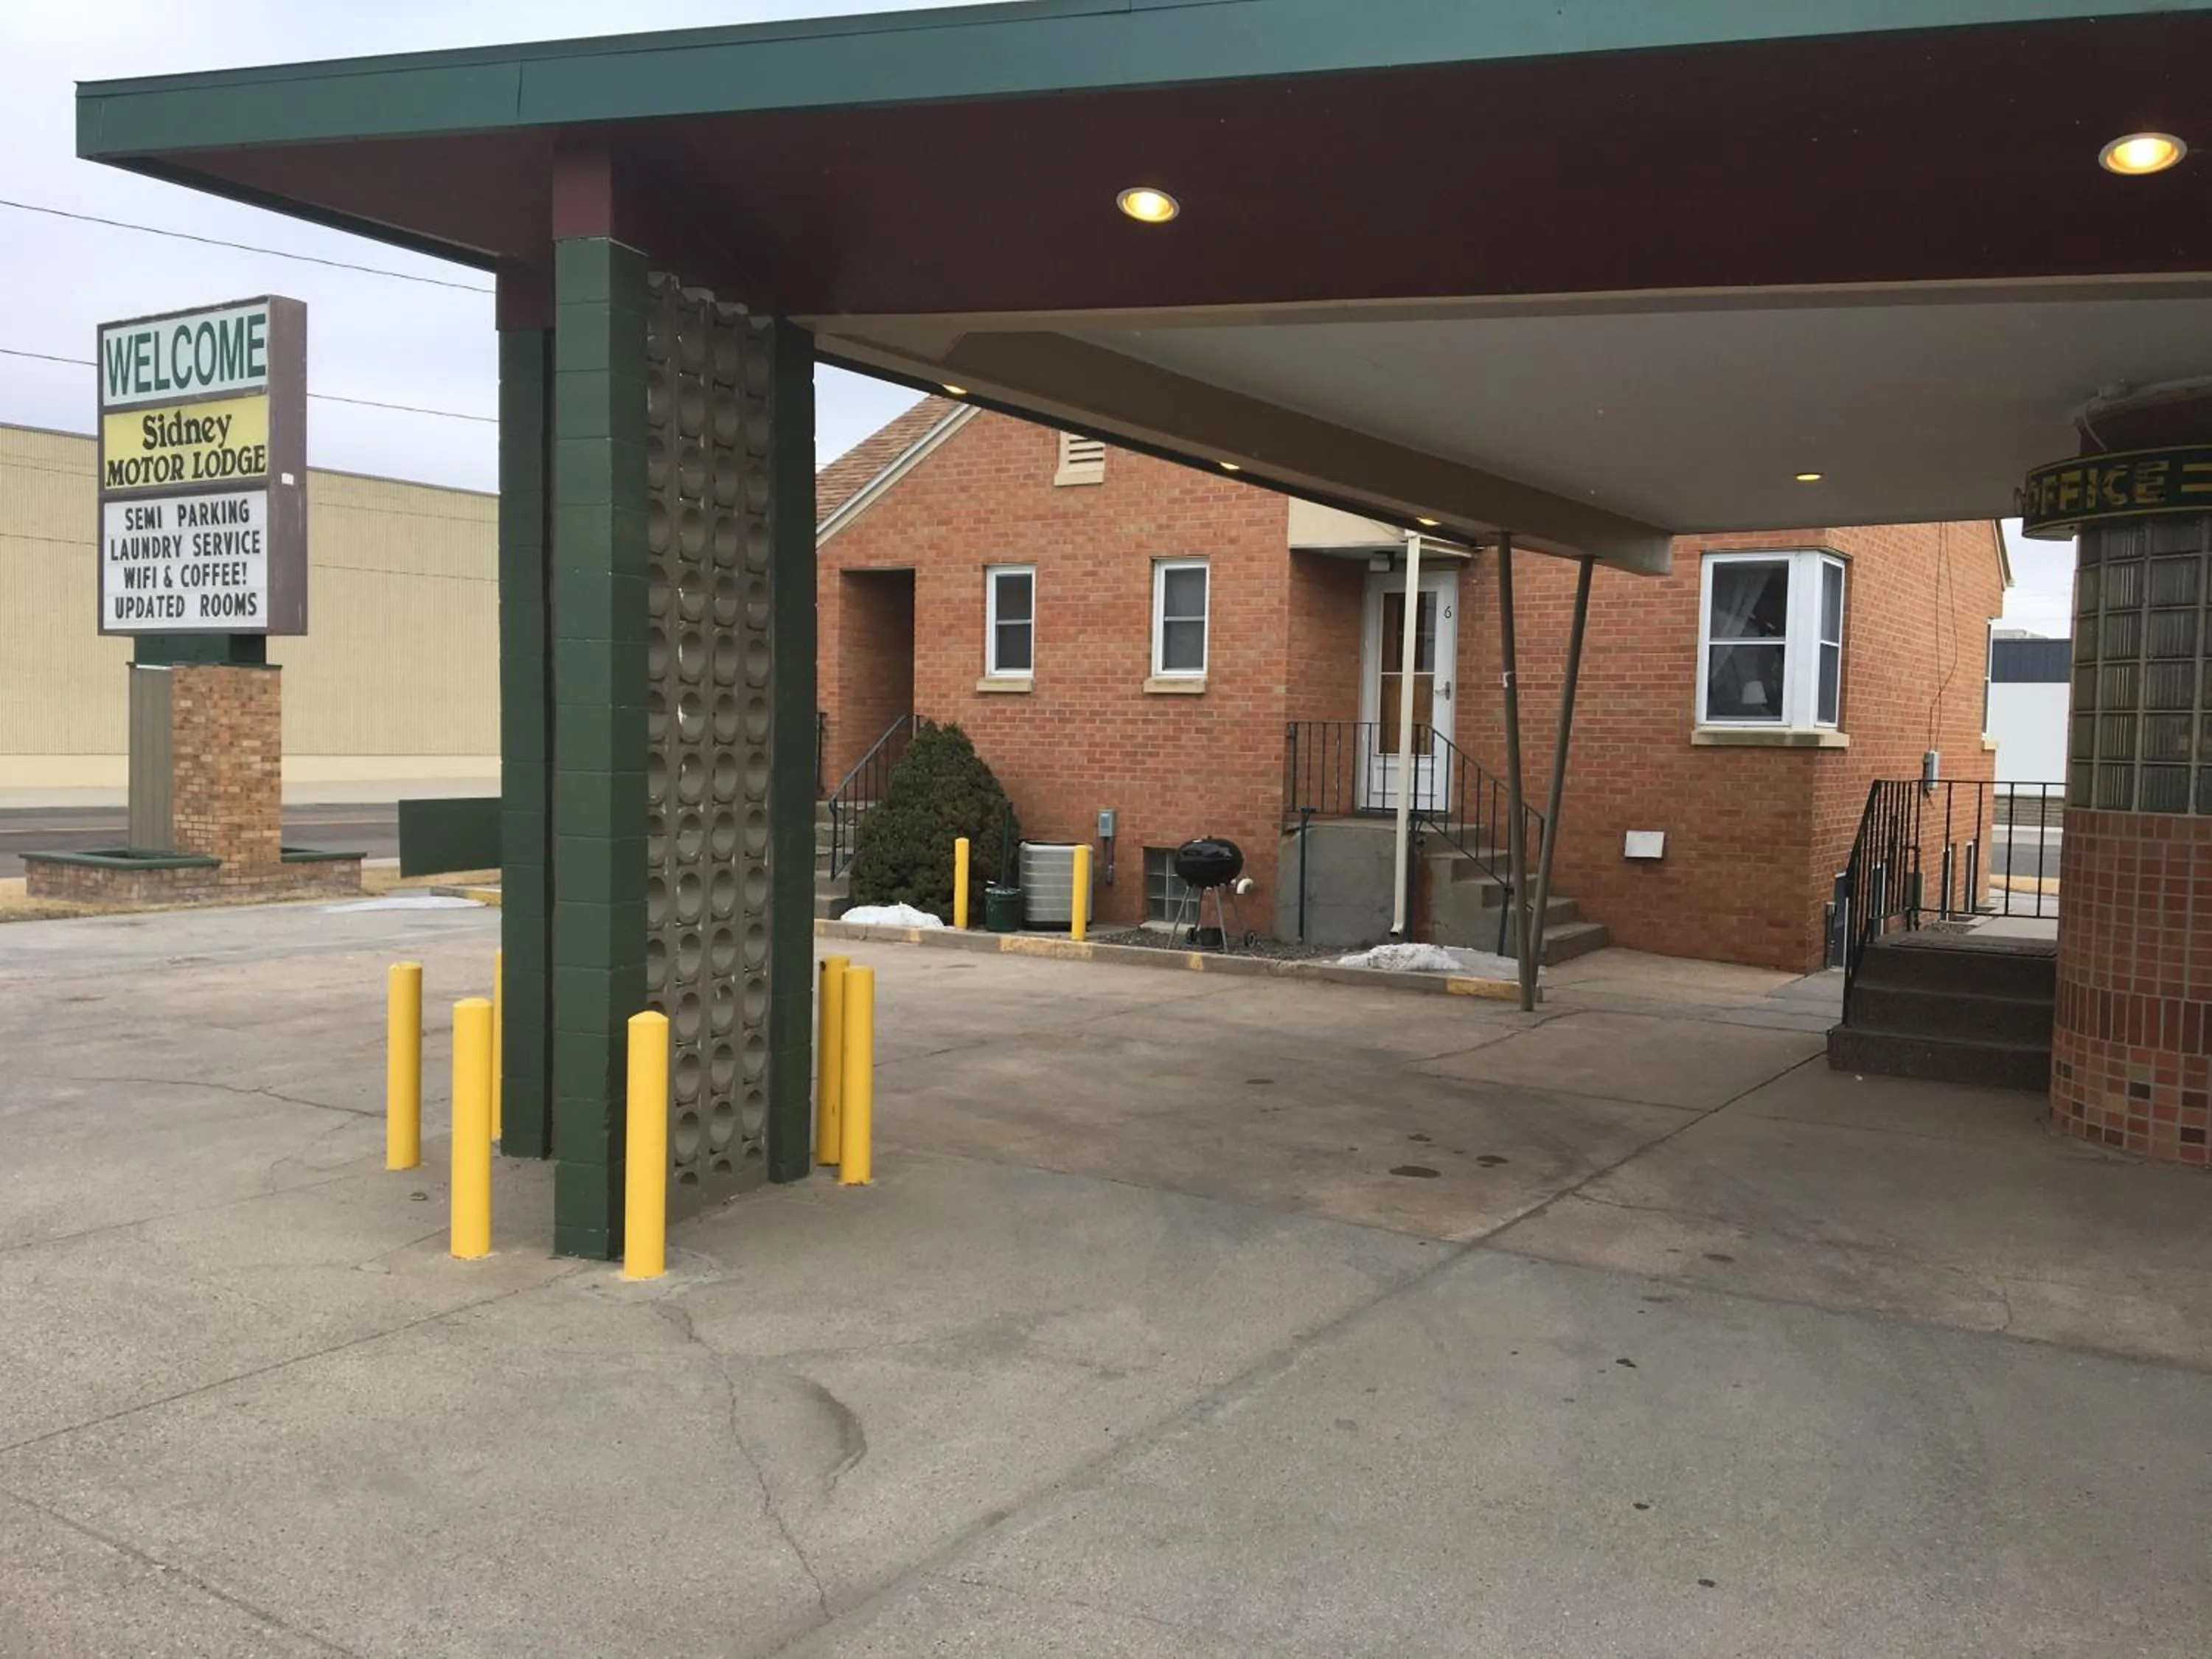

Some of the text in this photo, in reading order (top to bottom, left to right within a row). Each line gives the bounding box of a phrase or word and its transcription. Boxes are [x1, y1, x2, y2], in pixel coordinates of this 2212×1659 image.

[105, 313, 265, 397] WELCOME
[142, 411, 232, 451] Sidney
[106, 445, 266, 487] MOTOR LODGE
[125, 499, 249, 531] SEMI PARKING
[111, 530, 260, 561] LAUNDRY SERVICE
[124, 562, 247, 589] WIFI & COFFEE!
[115, 593, 257, 619] UPDATED ROOMS
[1444, 605, 1452, 619] 6
